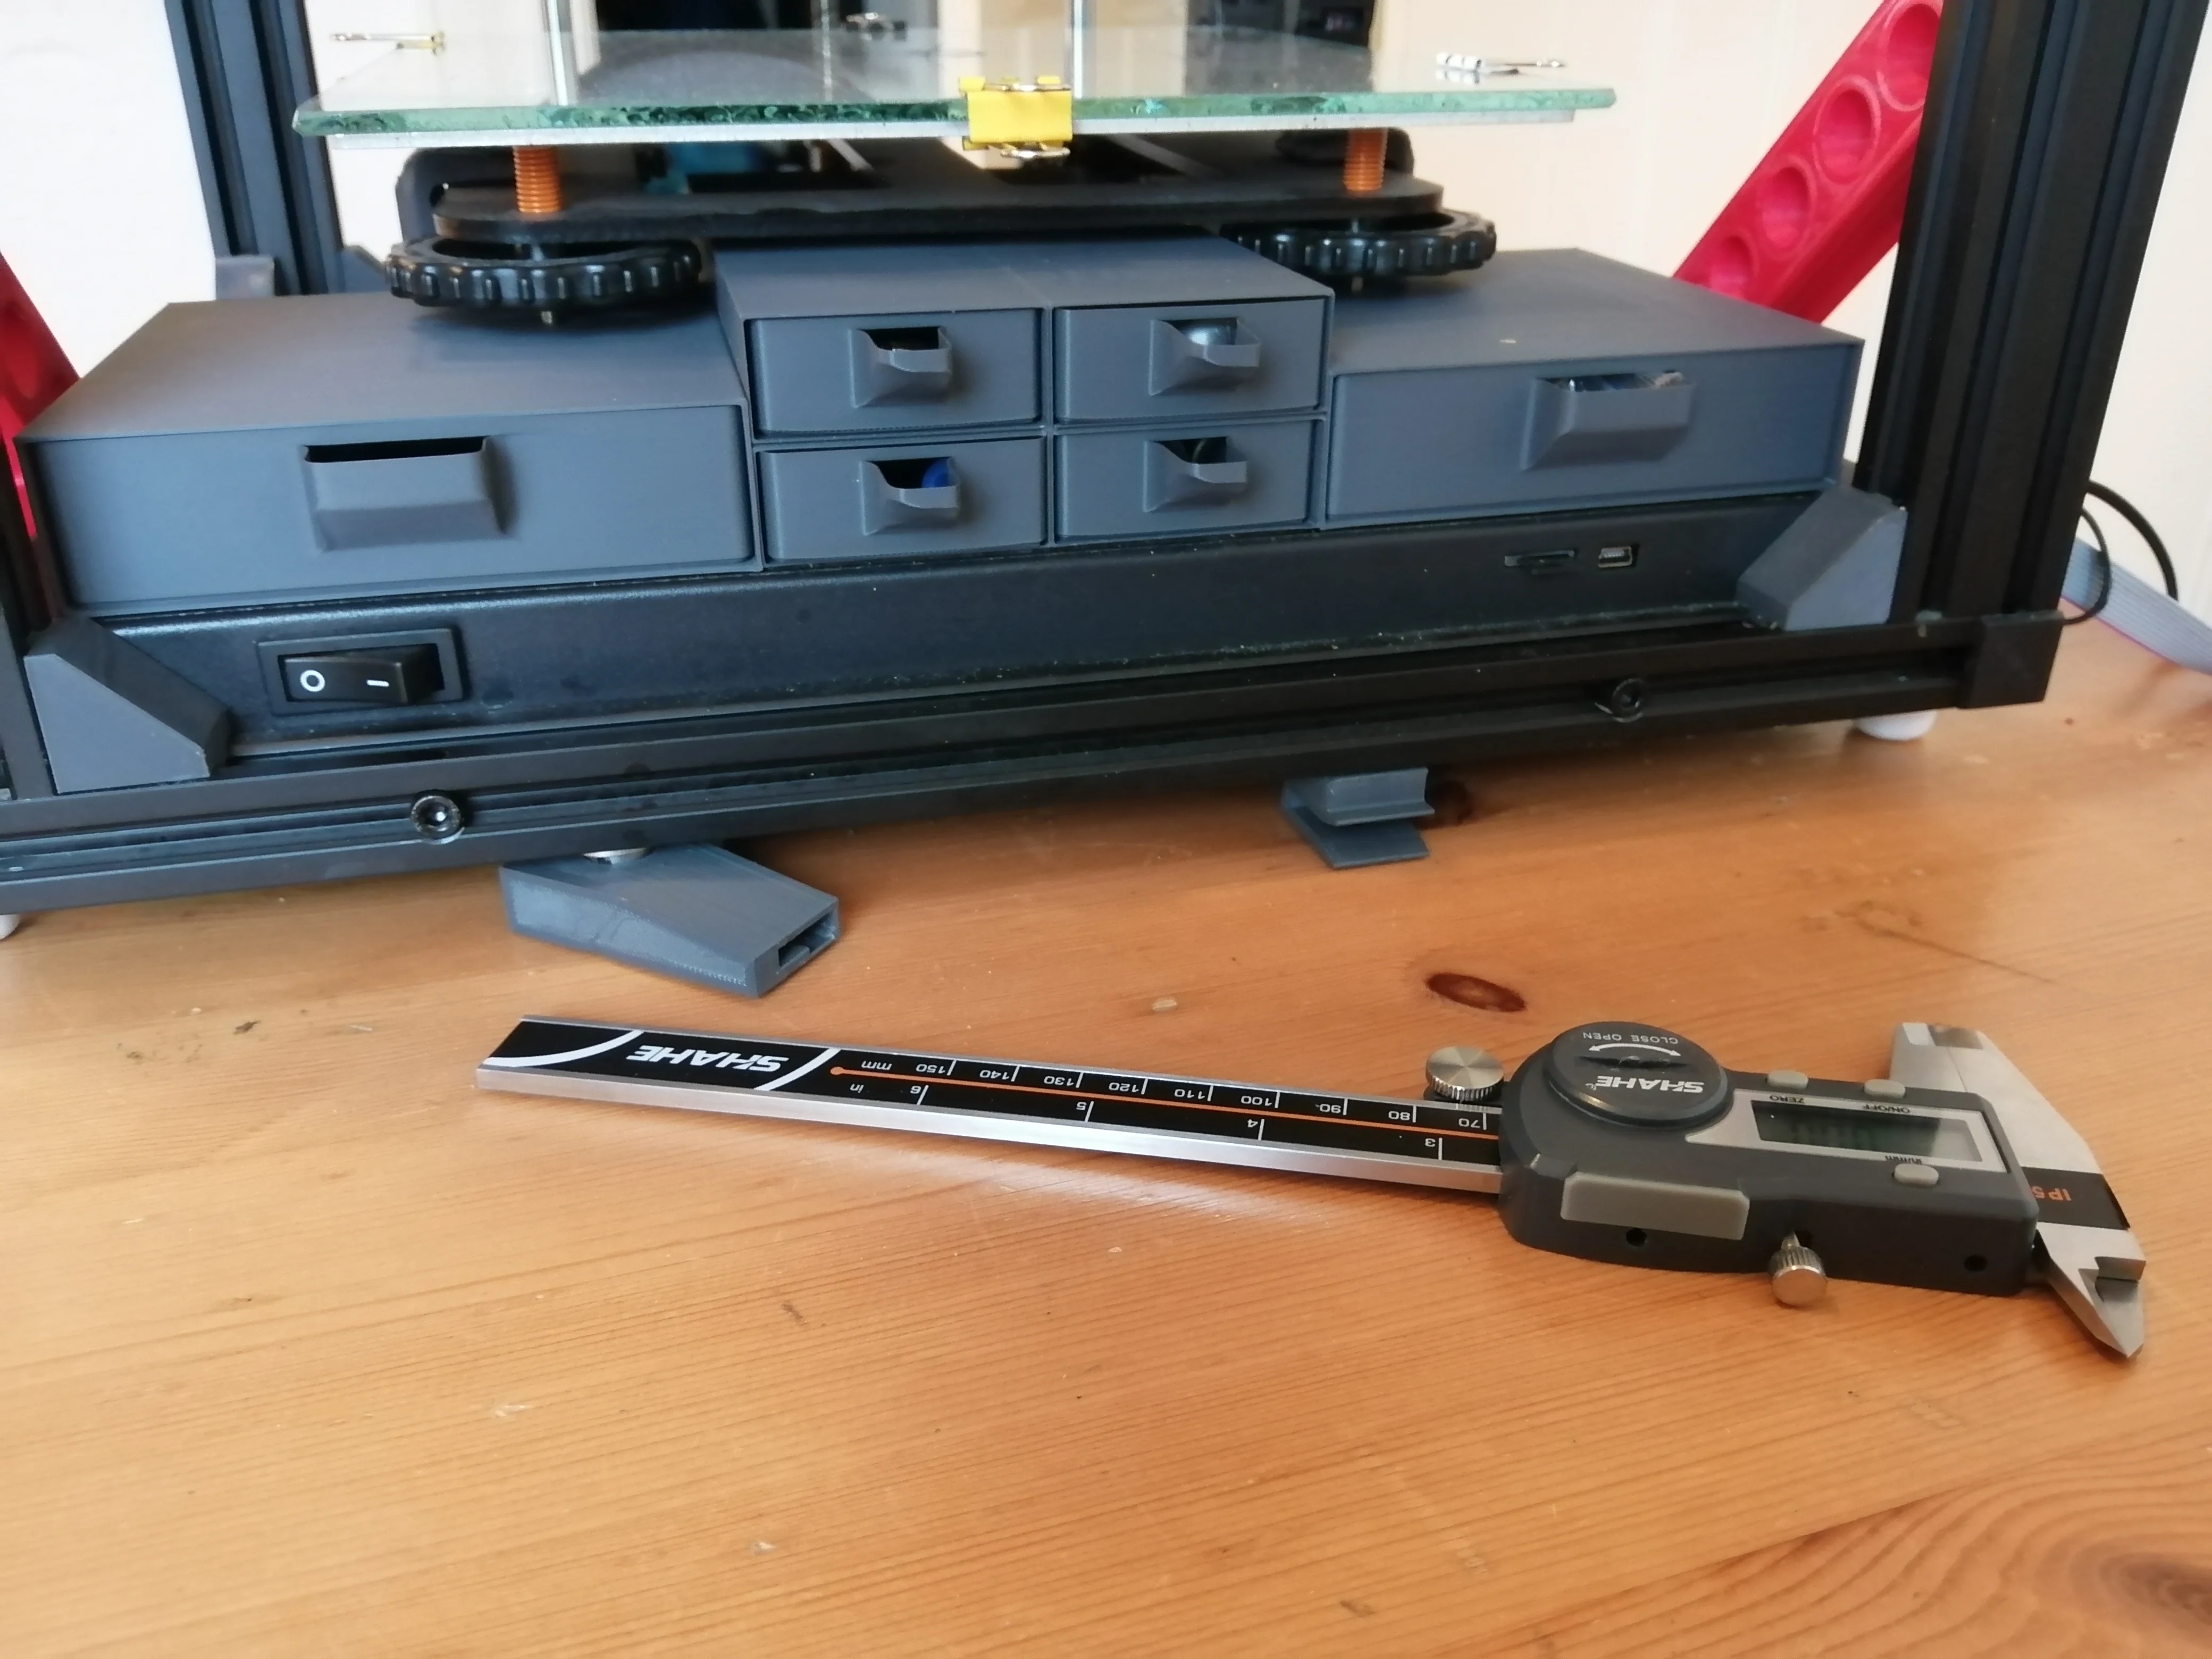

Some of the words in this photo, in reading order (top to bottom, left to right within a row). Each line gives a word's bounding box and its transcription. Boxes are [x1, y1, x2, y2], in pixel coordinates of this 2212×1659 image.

[1582, 1032, 1622, 1041] OPEN
[1630, 1034, 1679, 1045] CLOSE
[626, 1045, 790, 1073] SHAHE
[861, 1060, 892, 1071] mm
[916, 1063, 946, 1074] 150
[979, 1070, 1010, 1080] 140
[1043, 1076, 1074, 1086] 130
[1595, 1076, 1705, 1093] SHAHE
[850, 1084, 864, 1093] in
[910, 1085, 921, 1094] 6
[1109, 1082, 1139, 1093] 120
[1174, 1088, 1205, 1100] 110
[1241, 1095, 1272, 1106] 100
[1770, 1095, 1805, 1104] ZERO
[1076, 1101, 1087, 1111] 5
[1319, 1103, 1341, 1114] 90
[1863, 1104, 1911, 1113] ON/OFF
[1388, 1111, 1411, 1121] 80
[1247, 1119, 1258, 1128] 4
[1458, 1118, 1480, 1128] 70
[1425, 1138, 1436, 1147] 3
